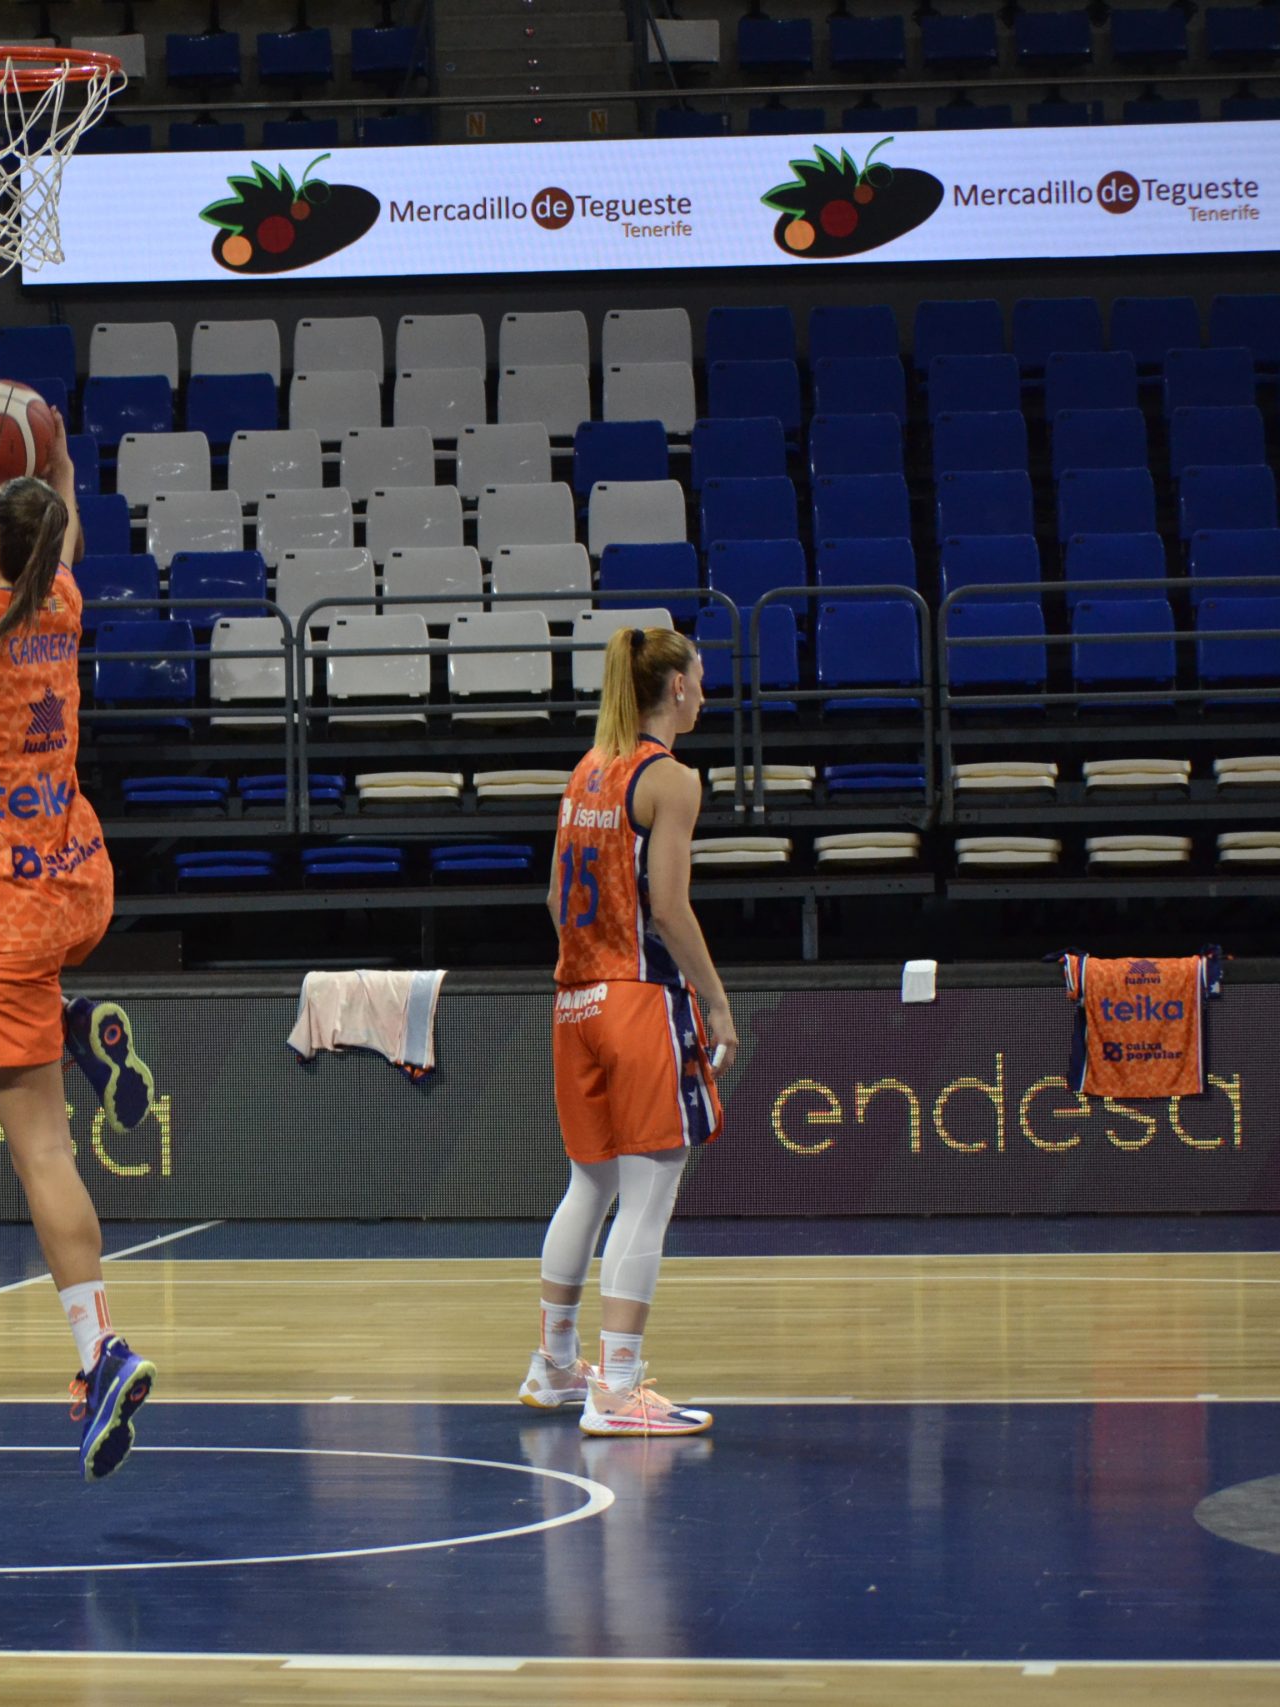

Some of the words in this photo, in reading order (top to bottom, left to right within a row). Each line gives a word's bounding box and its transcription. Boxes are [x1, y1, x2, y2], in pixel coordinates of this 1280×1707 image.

[953, 181, 1093, 207] Mercadillo
[1100, 176, 1134, 203] de
[1141, 177, 1259, 206] Tegueste
[389, 197, 527, 223] Mercadillo
[534, 193, 568, 219] de
[575, 194, 692, 222] Tegueste
[1188, 205, 1260, 223] Tenerife
[622, 221, 693, 239] Tenerife
[573, 803, 621, 829] isaval
[560, 843, 600, 928] 15
[1100, 994, 1184, 1022] teika
[1126, 1041, 1162, 1050] caixa
[1126, 1050, 1183, 1061] popular
[771, 1053, 1242, 1153] endesa
